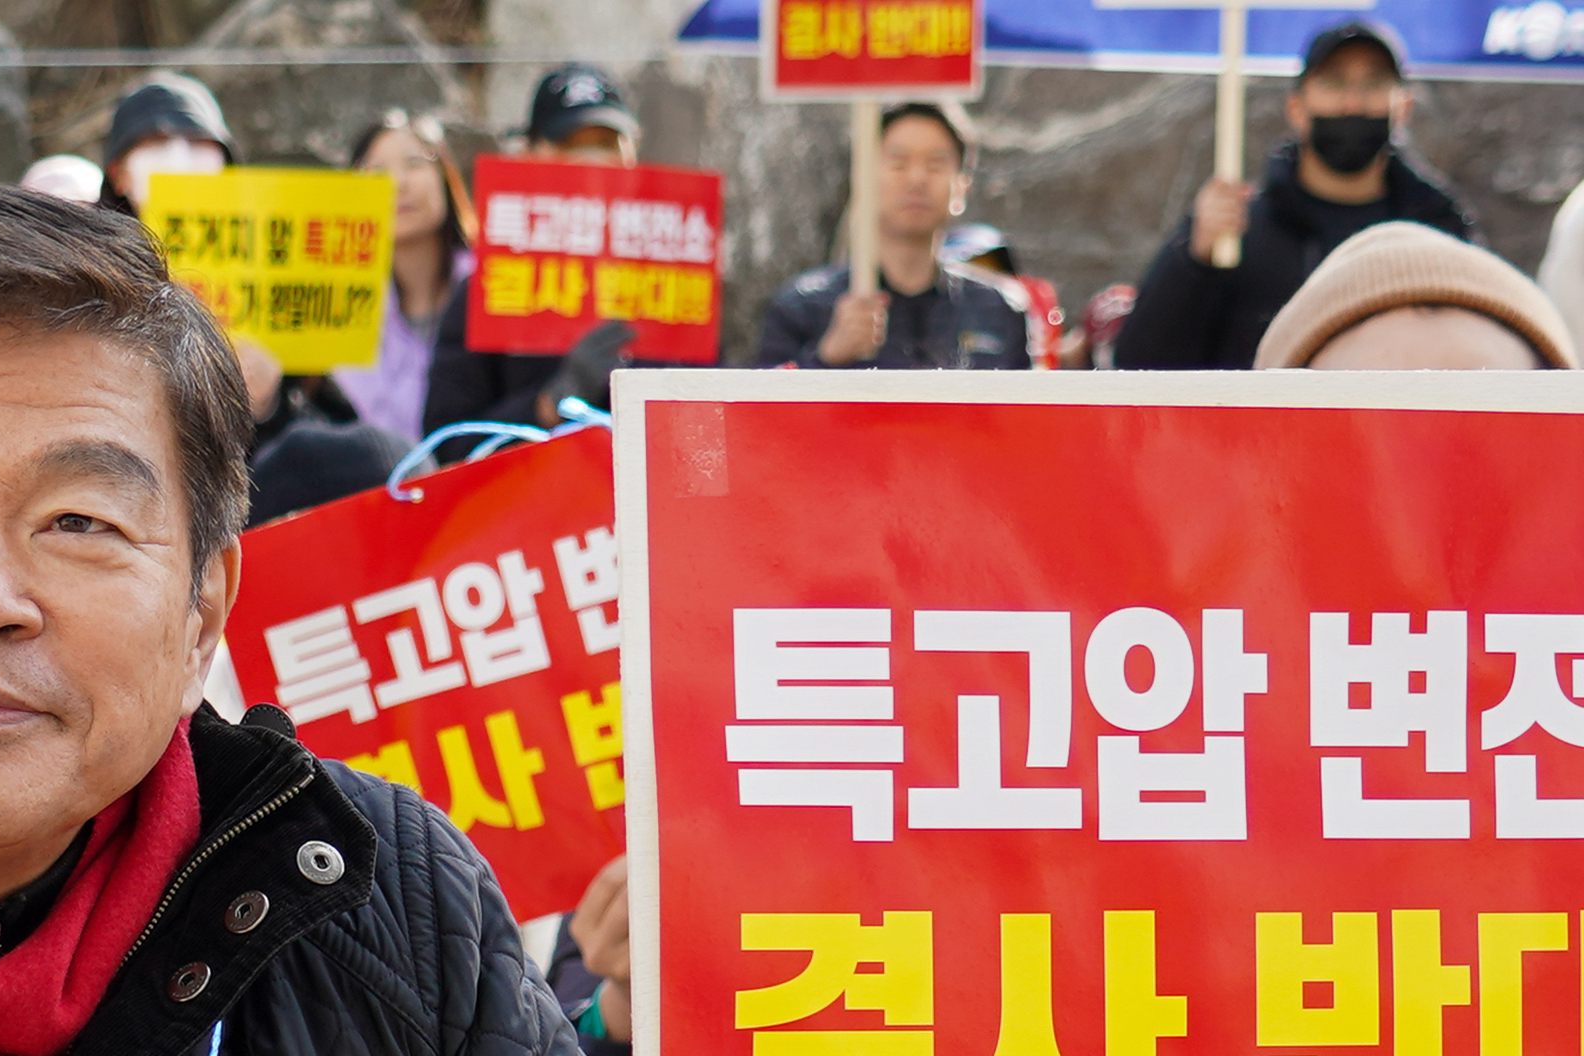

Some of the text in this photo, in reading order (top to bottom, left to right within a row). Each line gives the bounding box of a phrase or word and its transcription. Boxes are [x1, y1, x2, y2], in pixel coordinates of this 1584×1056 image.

[165, 214, 378, 267] 주거지 앞 특고압
[485, 193, 715, 263] 특고압 변전소
[482, 256, 588, 317] 결사
[263, 549, 552, 726] 특고압
[724, 606, 1268, 842] 특고압
